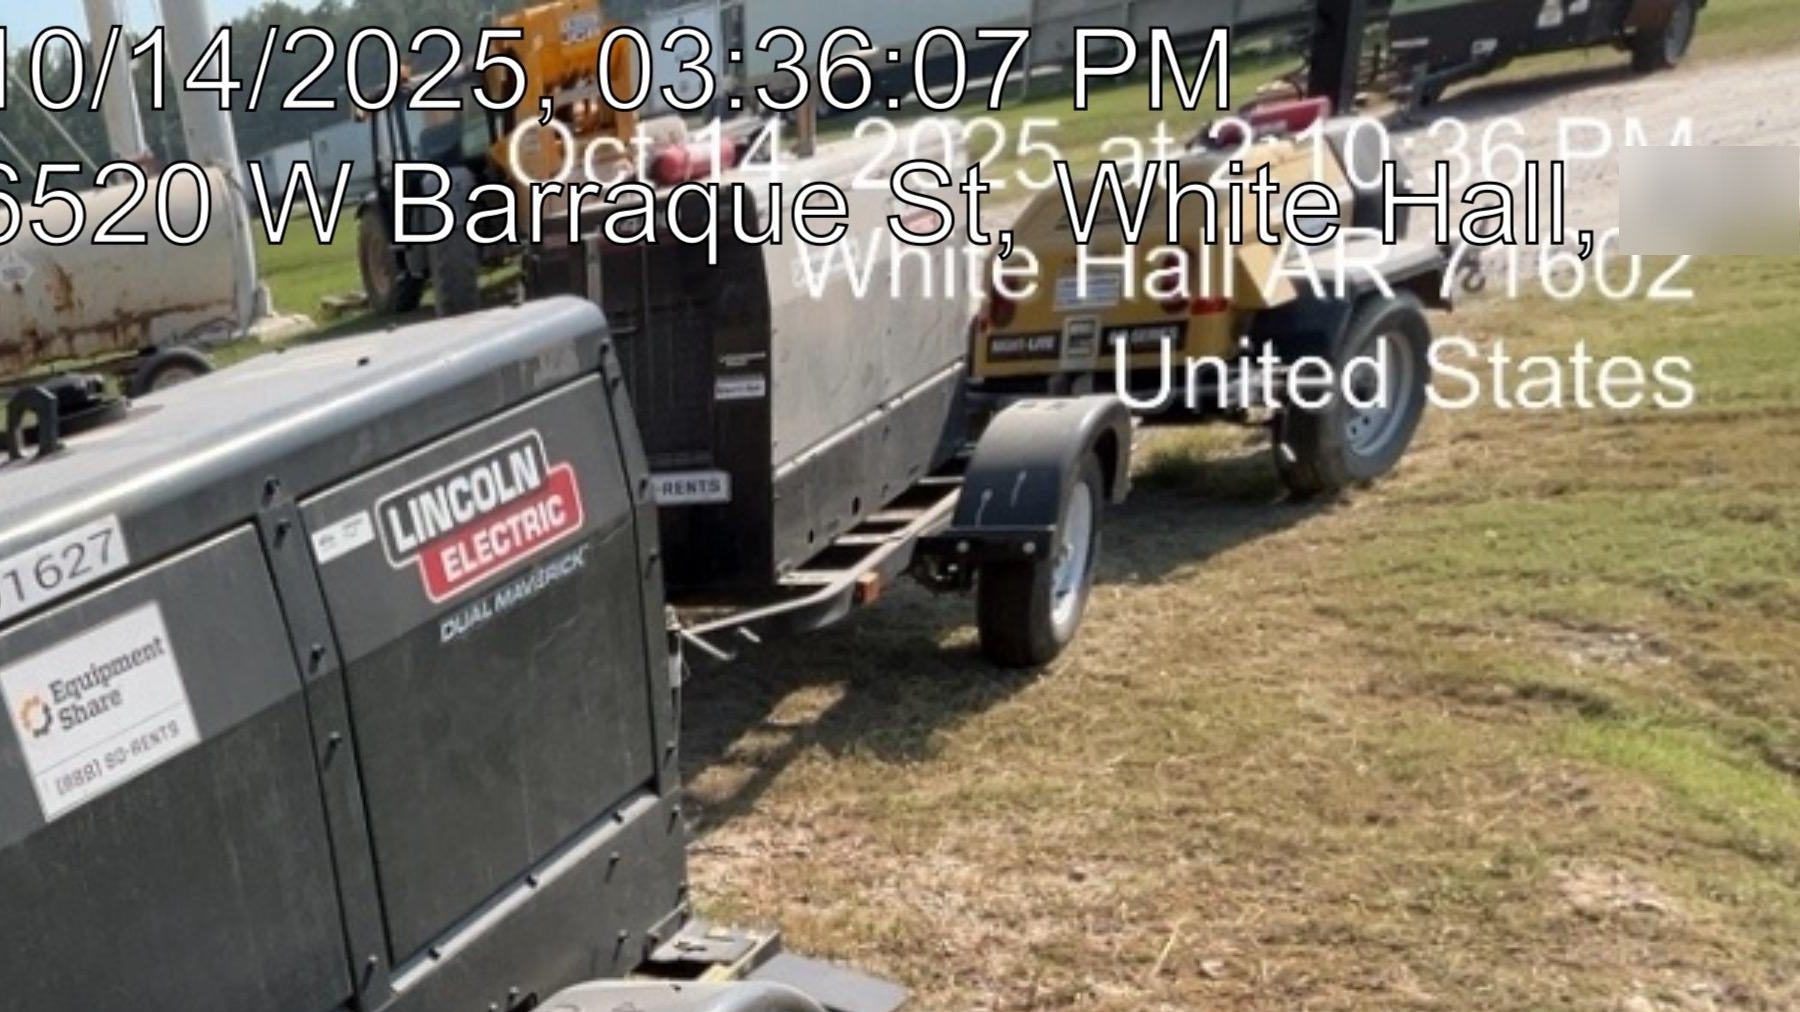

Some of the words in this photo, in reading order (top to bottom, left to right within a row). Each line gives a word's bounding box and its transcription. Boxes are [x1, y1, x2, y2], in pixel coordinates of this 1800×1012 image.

[387, 445, 541, 553] LINCOLN
[440, 494, 568, 583] ELECTRIC
[440, 602, 493, 643] DUAL
[48, 636, 166, 704] Equipment
[57, 688, 124, 731] Share
